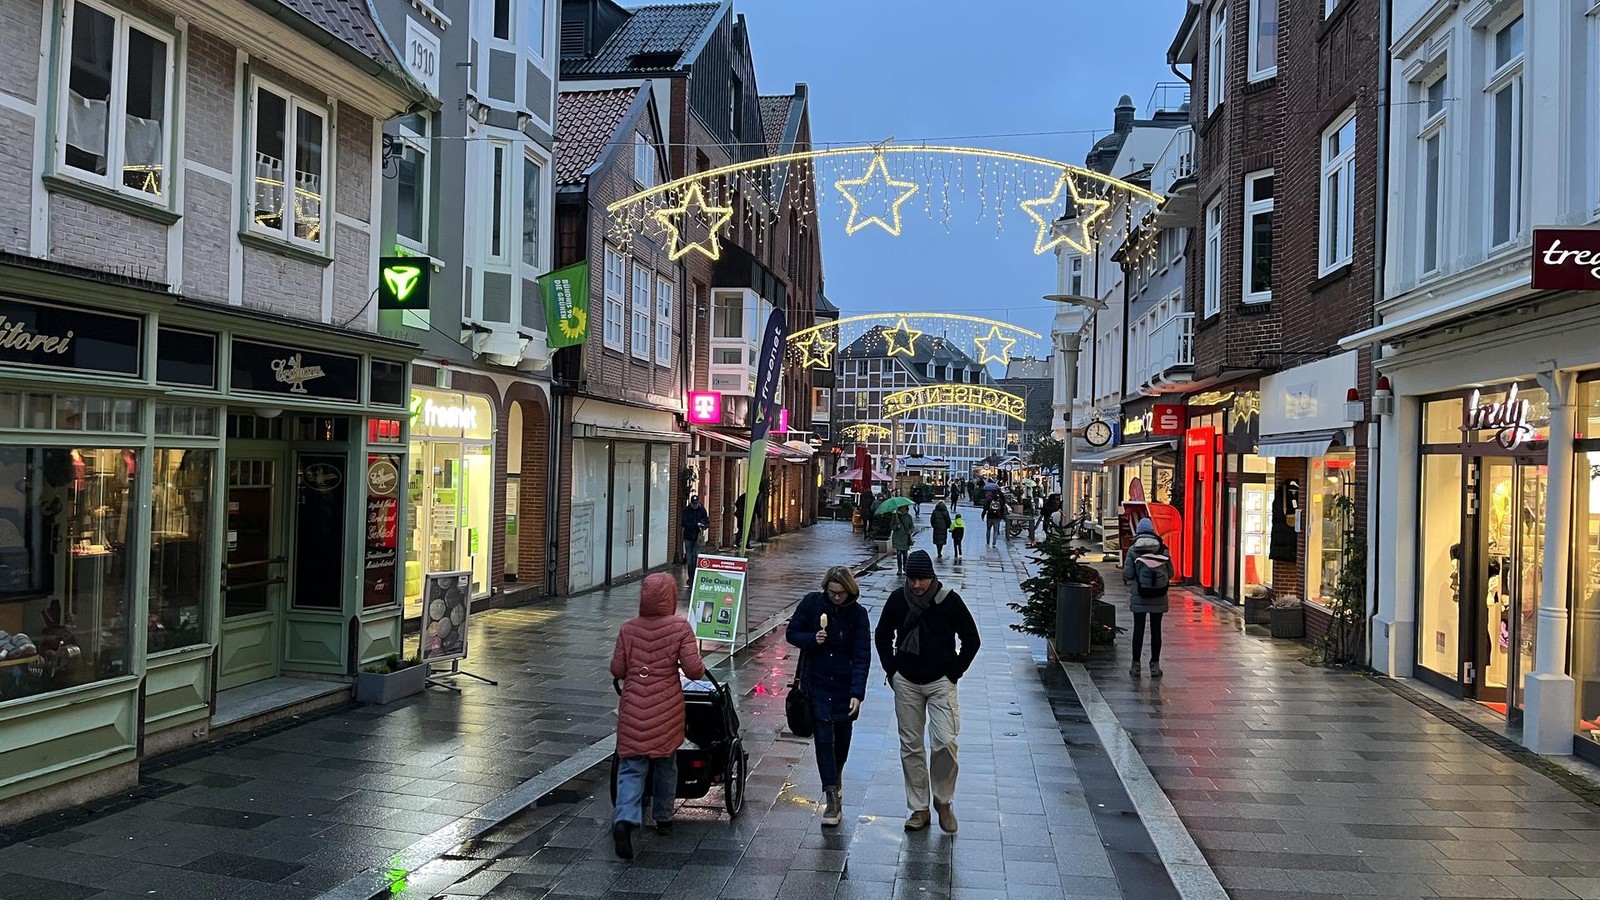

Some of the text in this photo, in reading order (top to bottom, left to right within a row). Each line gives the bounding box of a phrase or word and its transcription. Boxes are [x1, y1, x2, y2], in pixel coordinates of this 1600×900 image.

[411, 40, 435, 77] 1910
[554, 279, 563, 291] DIE
[424, 398, 479, 430] freenet
[1461, 383, 1534, 450] tredy
